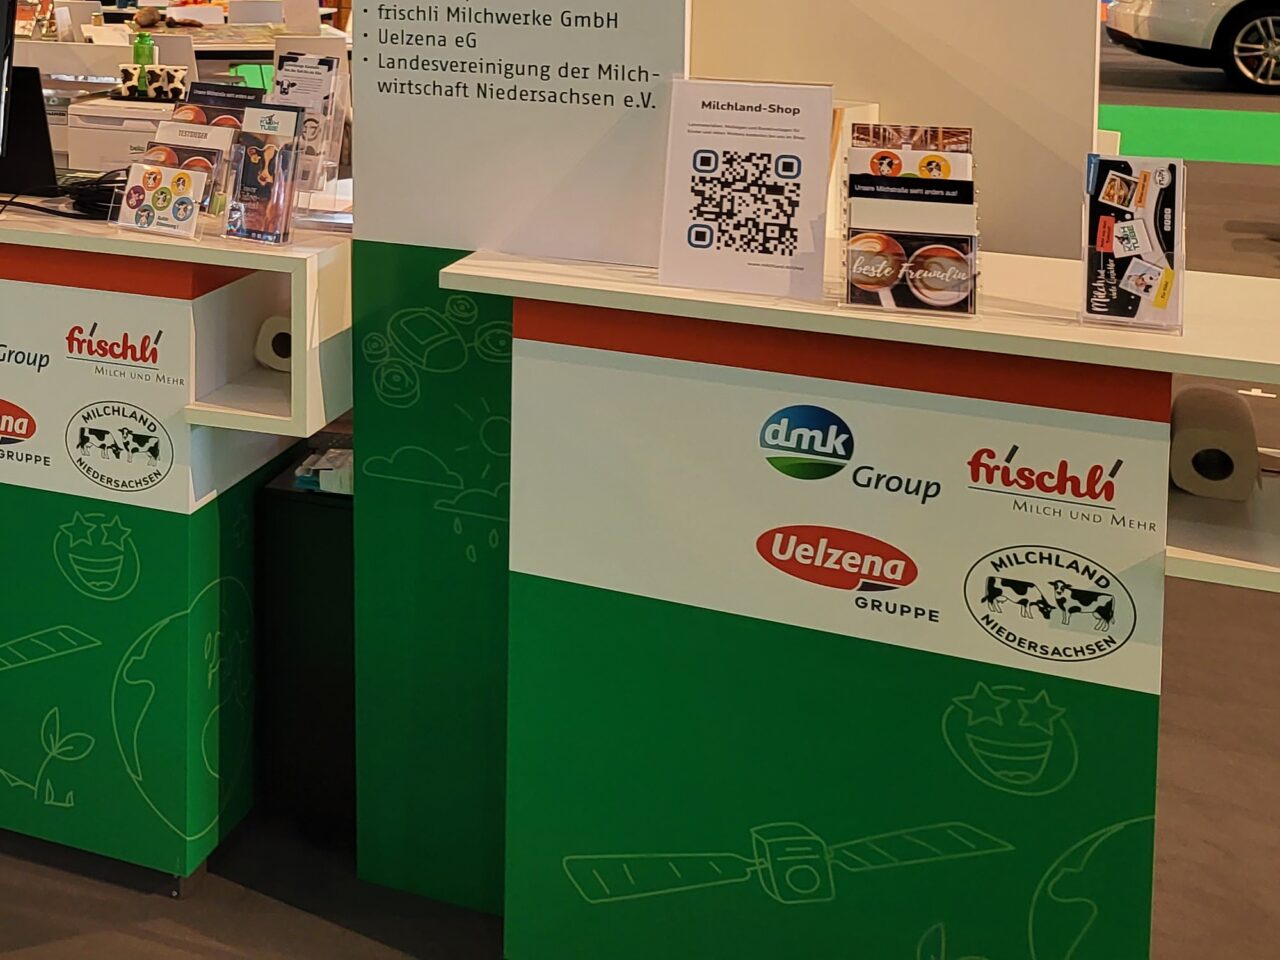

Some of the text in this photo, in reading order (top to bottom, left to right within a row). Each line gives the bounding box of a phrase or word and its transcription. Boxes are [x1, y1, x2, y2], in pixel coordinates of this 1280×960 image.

[378, 5, 618, 29] frischli Milchwerke GmbH
[379, 30, 477, 48] Uelzena eG
[379, 54, 660, 82] Landesvereinigung der Milch-
[378, 79, 656, 109] wirtschaft Niedersachsen e.V.
[701, 100, 800, 116] Milchland-Shop
[1128, 225, 1141, 250] TUBE
[852, 256, 971, 281] beste Freundin
[1091, 278, 1109, 312] Milch
[94, 365, 184, 386] MILCH UND MEHR
[82, 406, 157, 433] MILCHLAND
[764, 418, 849, 457] dmk
[76, 457, 163, 489] NIEDERSACHSEN
[852, 466, 941, 504] Group
[1013, 499, 1157, 532] MILCH UND MEHR
[771, 533, 906, 581] Uelzena
[990, 552, 1111, 590] MILCHLAND
[855, 596, 940, 623] GRUPPE
[981, 613, 1117, 658] NIEDERSACHSEN
